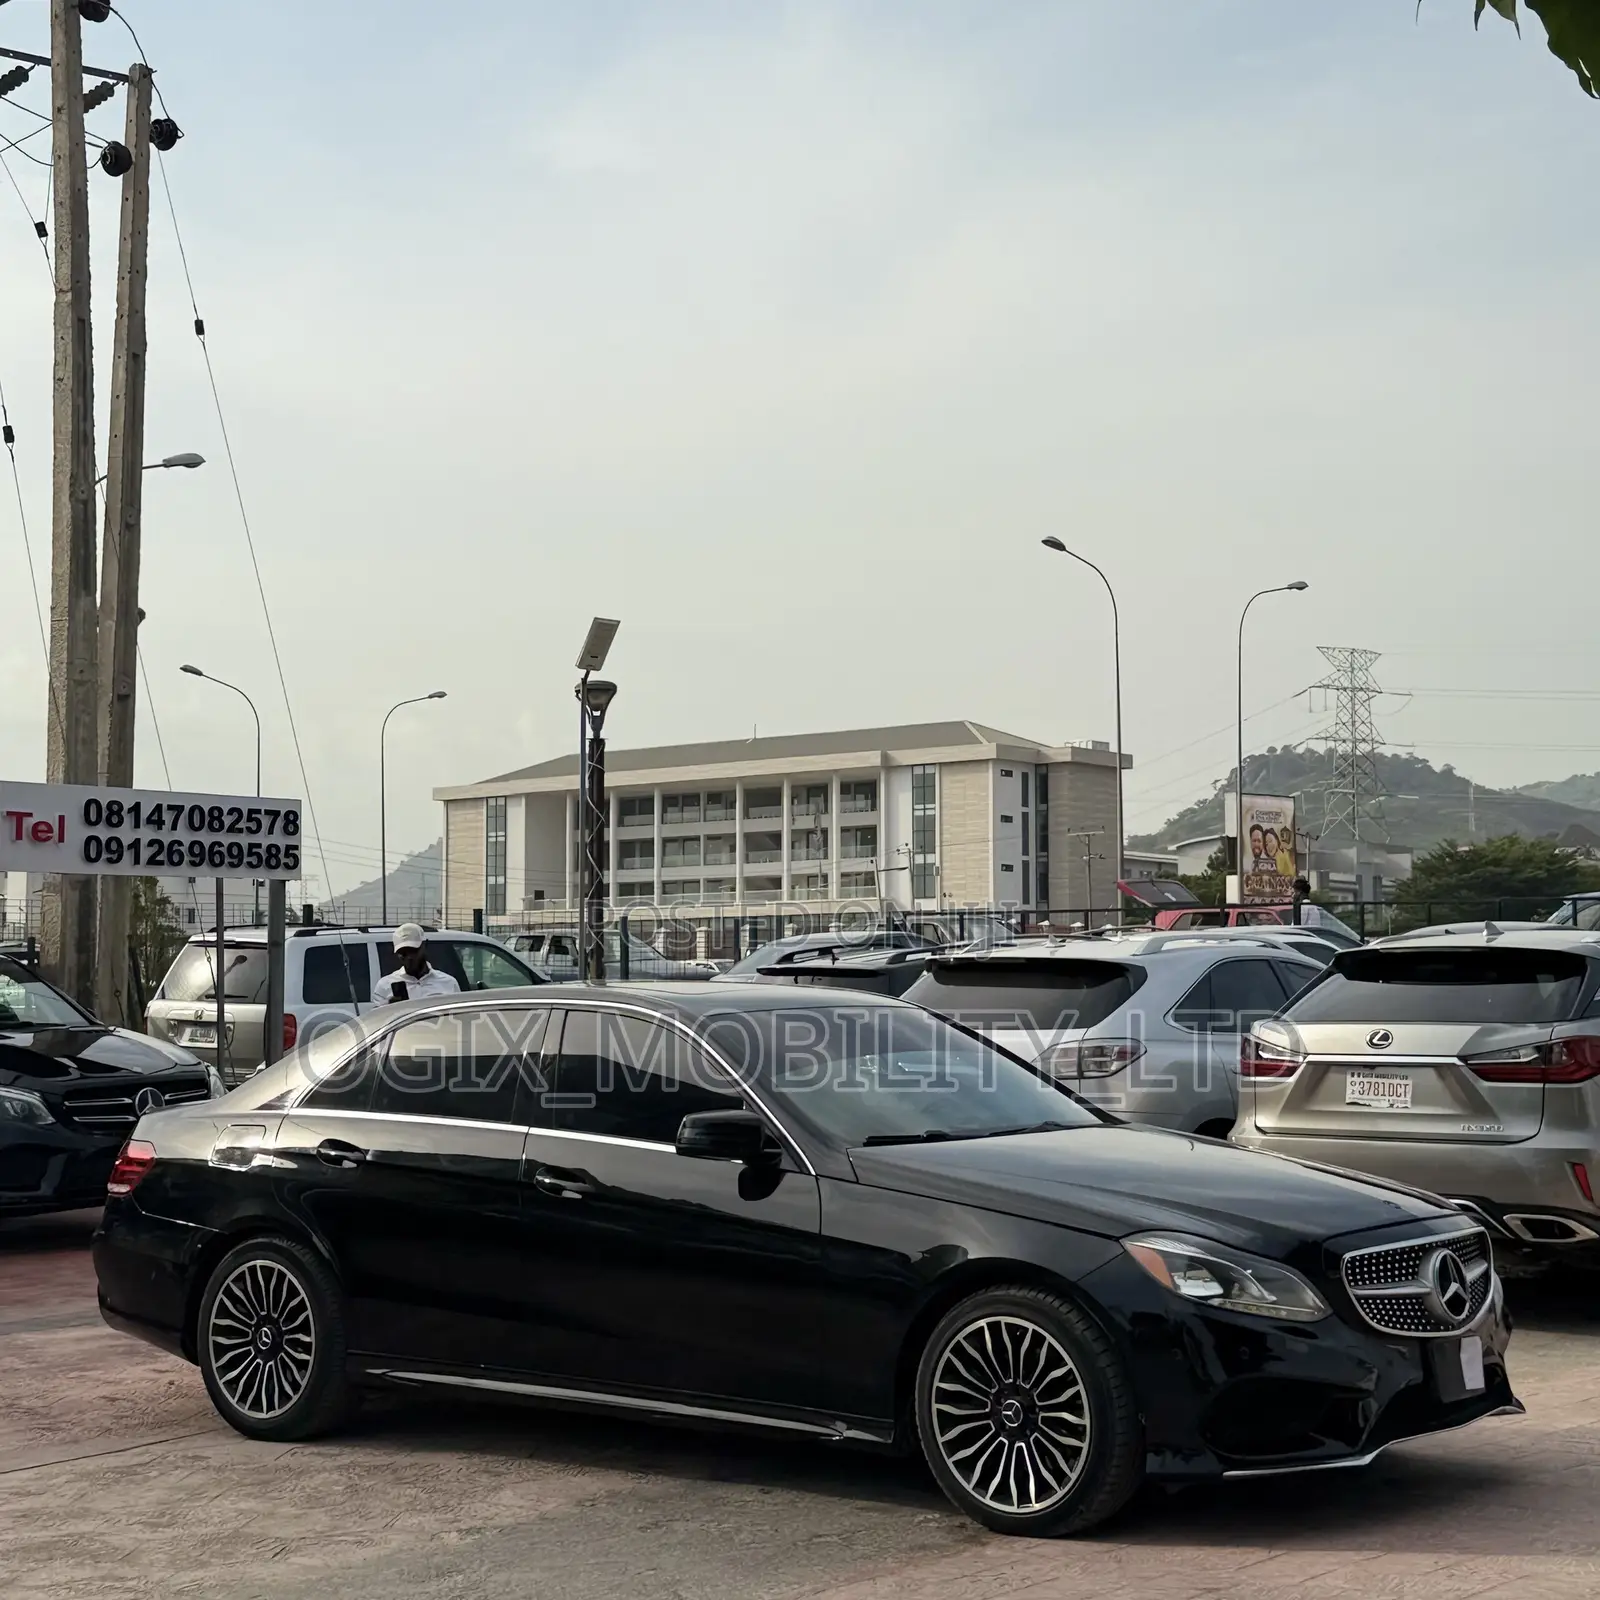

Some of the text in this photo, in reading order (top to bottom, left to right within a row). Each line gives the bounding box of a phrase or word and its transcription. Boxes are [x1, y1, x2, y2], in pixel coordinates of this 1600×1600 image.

[6, 811, 65, 844] Tel
[83, 798, 299, 836] 08147082578
[83, 835, 299, 870] 09126969585
